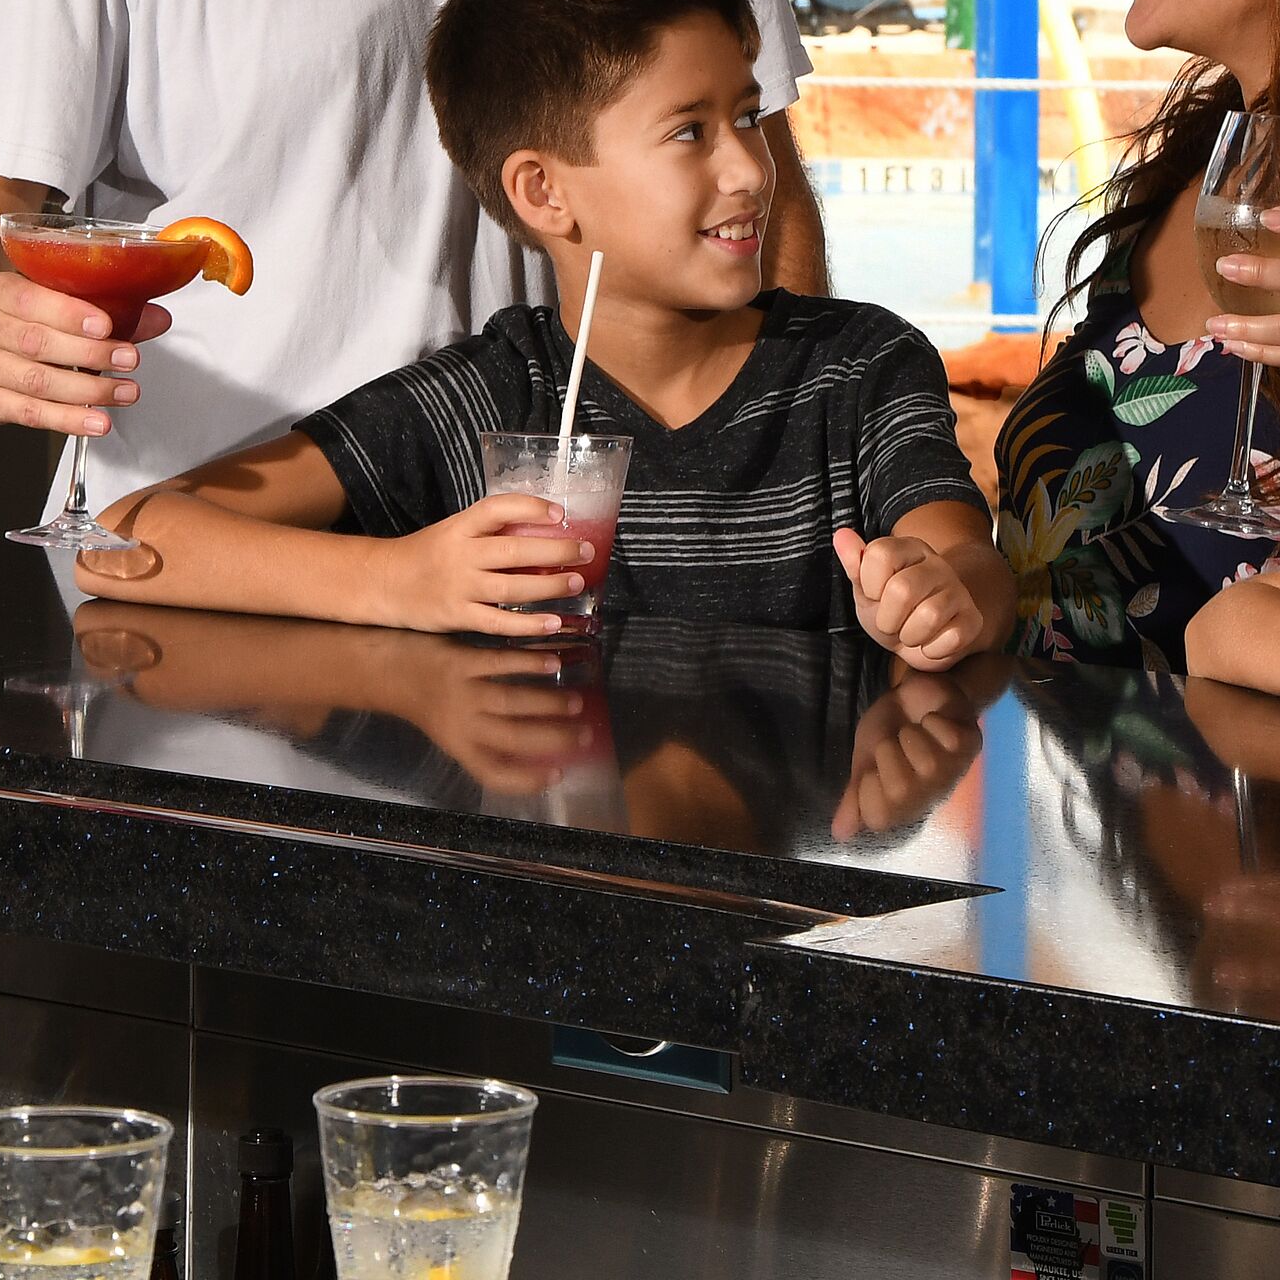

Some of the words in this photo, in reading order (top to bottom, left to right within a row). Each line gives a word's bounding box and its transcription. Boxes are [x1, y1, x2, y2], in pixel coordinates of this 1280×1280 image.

[885, 166, 913, 193] FT
[930, 166, 944, 193] 3
[1039, 1215, 1072, 1231] Perlick
[1106, 1246, 1125, 1255] GREEN
